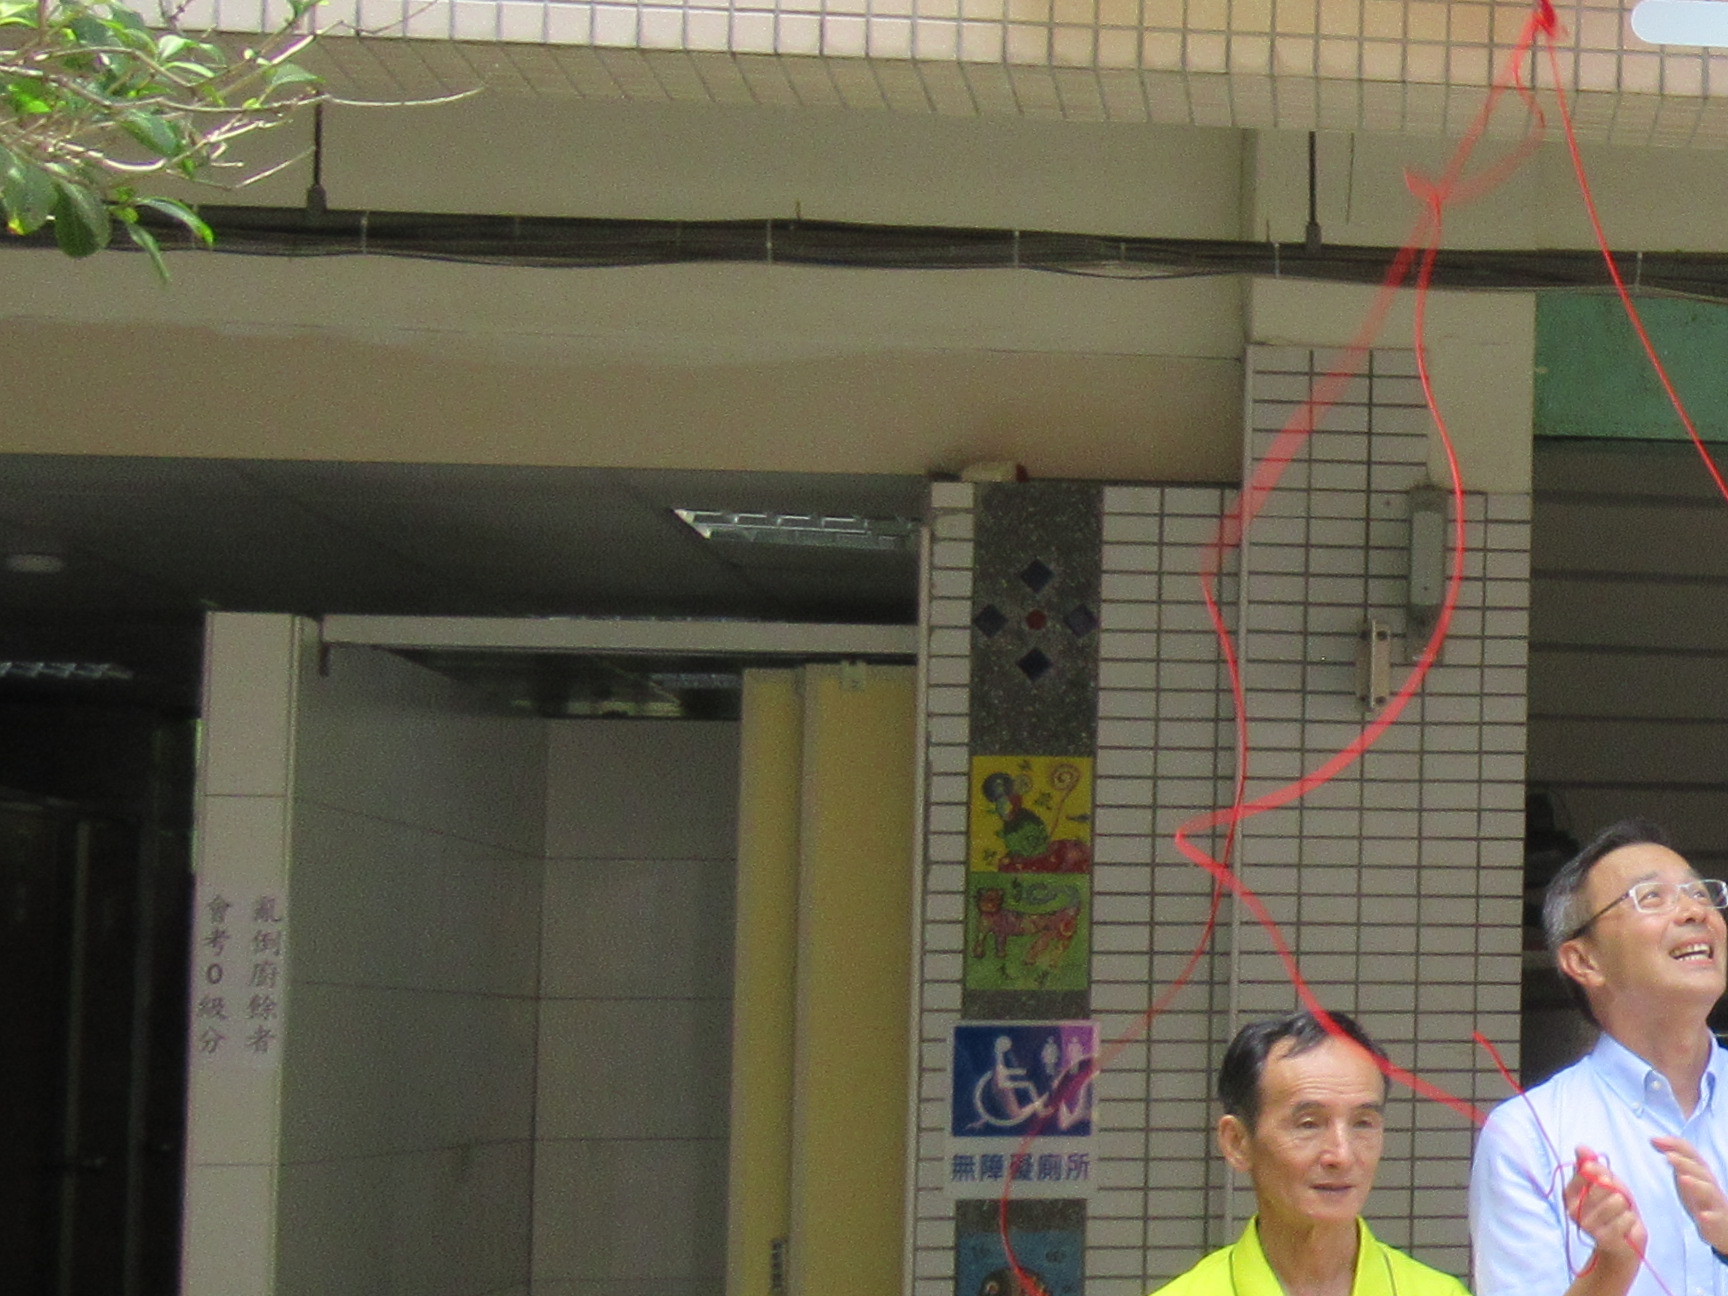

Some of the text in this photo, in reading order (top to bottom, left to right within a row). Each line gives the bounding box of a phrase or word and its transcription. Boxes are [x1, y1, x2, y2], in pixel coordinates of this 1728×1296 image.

[951, 1153, 1090, 1182] 無障礙廁所
